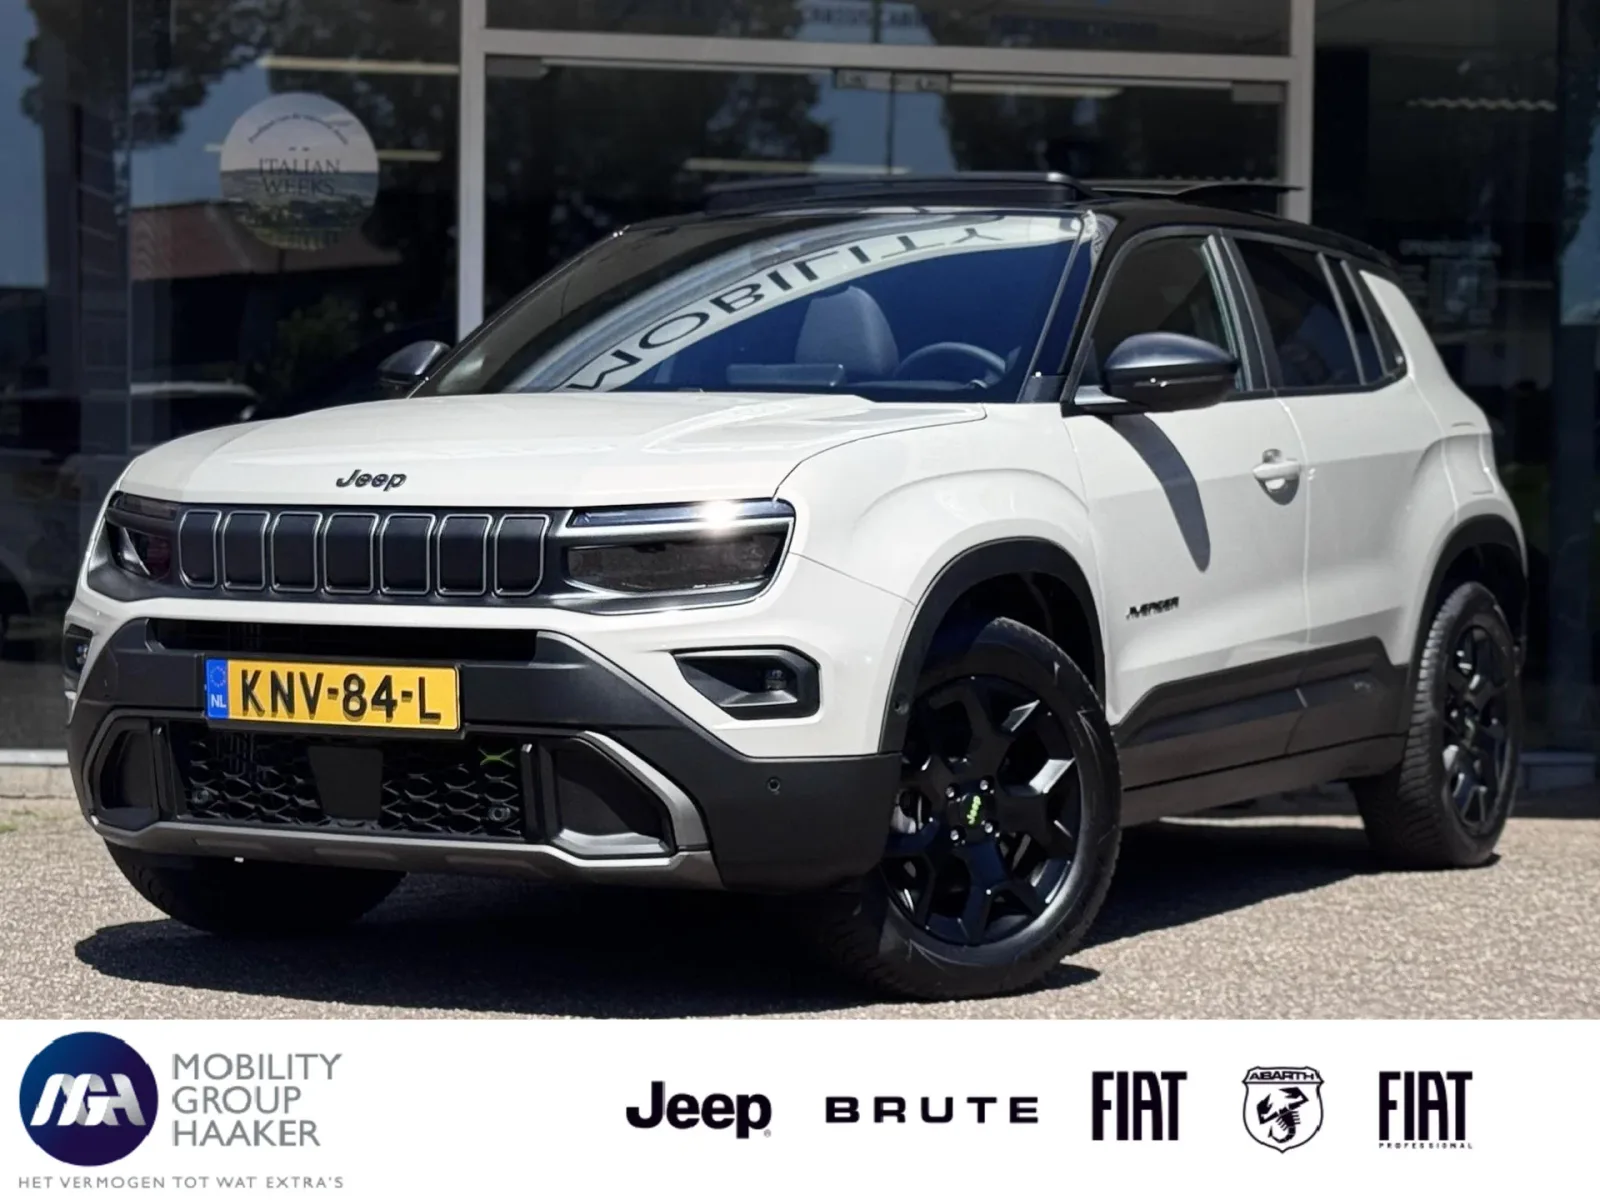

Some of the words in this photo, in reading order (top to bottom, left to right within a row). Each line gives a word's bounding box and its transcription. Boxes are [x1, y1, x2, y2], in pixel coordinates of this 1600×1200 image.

[258, 158, 341, 175] ITALIAN
[261, 177, 336, 195] WEEKS
[336, 469, 407, 492] Jeep
[210, 693, 227, 709] NL
[241, 669, 442, 724] KNV-84-L
[967, 795, 981, 825] Jeep
